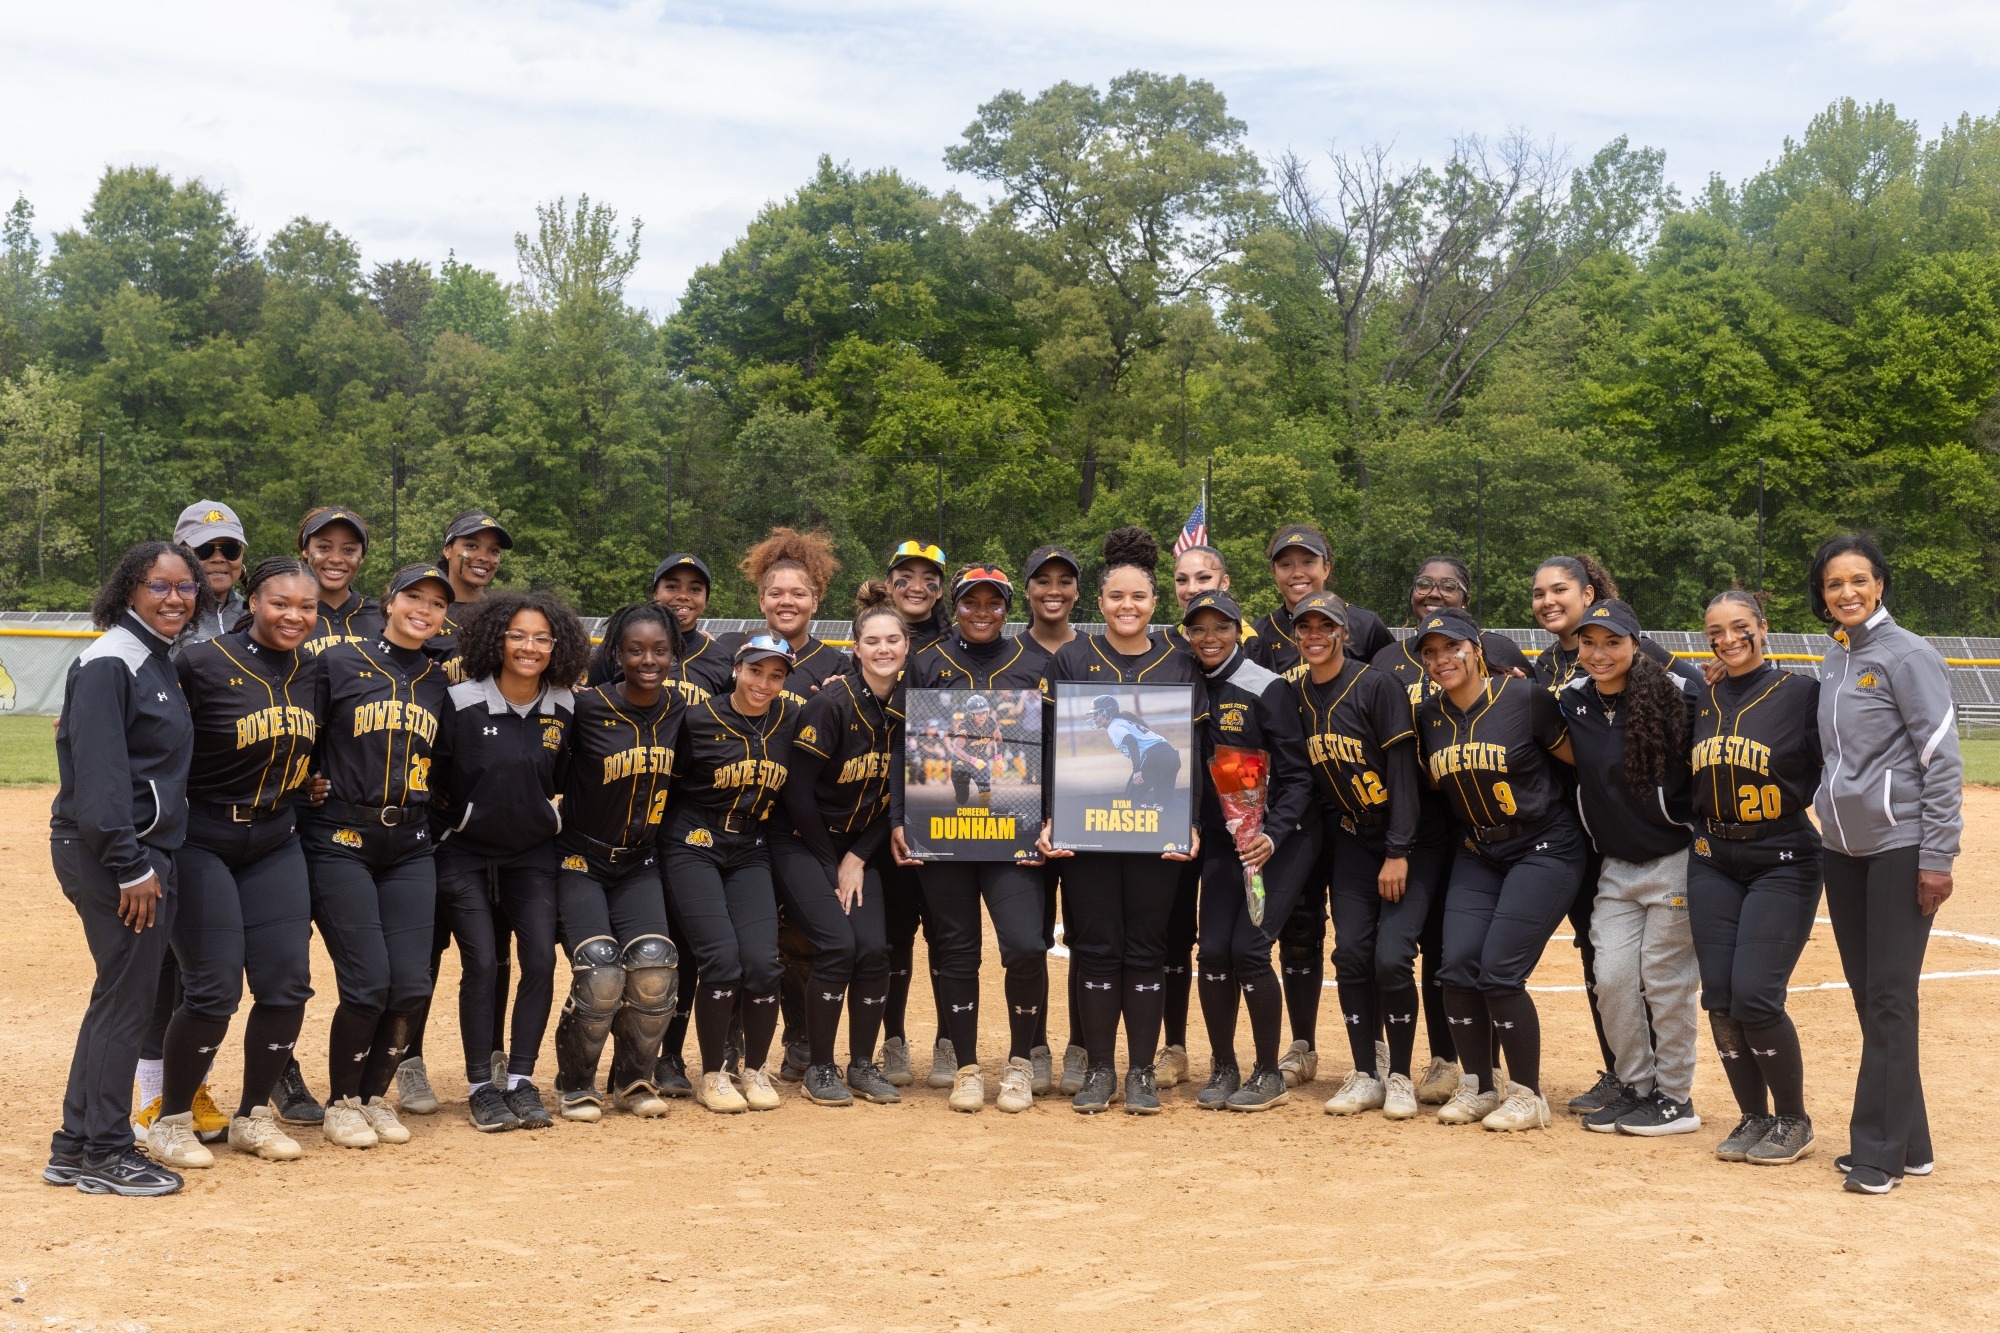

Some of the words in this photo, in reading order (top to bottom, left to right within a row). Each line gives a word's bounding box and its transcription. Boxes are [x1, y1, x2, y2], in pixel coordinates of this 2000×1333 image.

[236, 706, 285, 750] BOWIE
[353, 700, 403, 738] BOWIE
[1324, 733, 1367, 765] STATE
[1462, 742, 1508, 773] STATE
[1724, 735, 1771, 777] STATE
[603, 747, 647, 785] BOWIE
[713, 760, 757, 790] BOWIE
[836, 752, 880, 784] BOWIE
[1351, 771, 1388, 805] 12
[1492, 781, 1517, 815] 9
[1738, 785, 1781, 822] 20
[956, 807, 989, 817] COREENA
[1085, 808, 1158, 833] FRASER
[1112, 800, 1131, 809] RYAN
[930, 816, 1015, 840] DUNHAM
